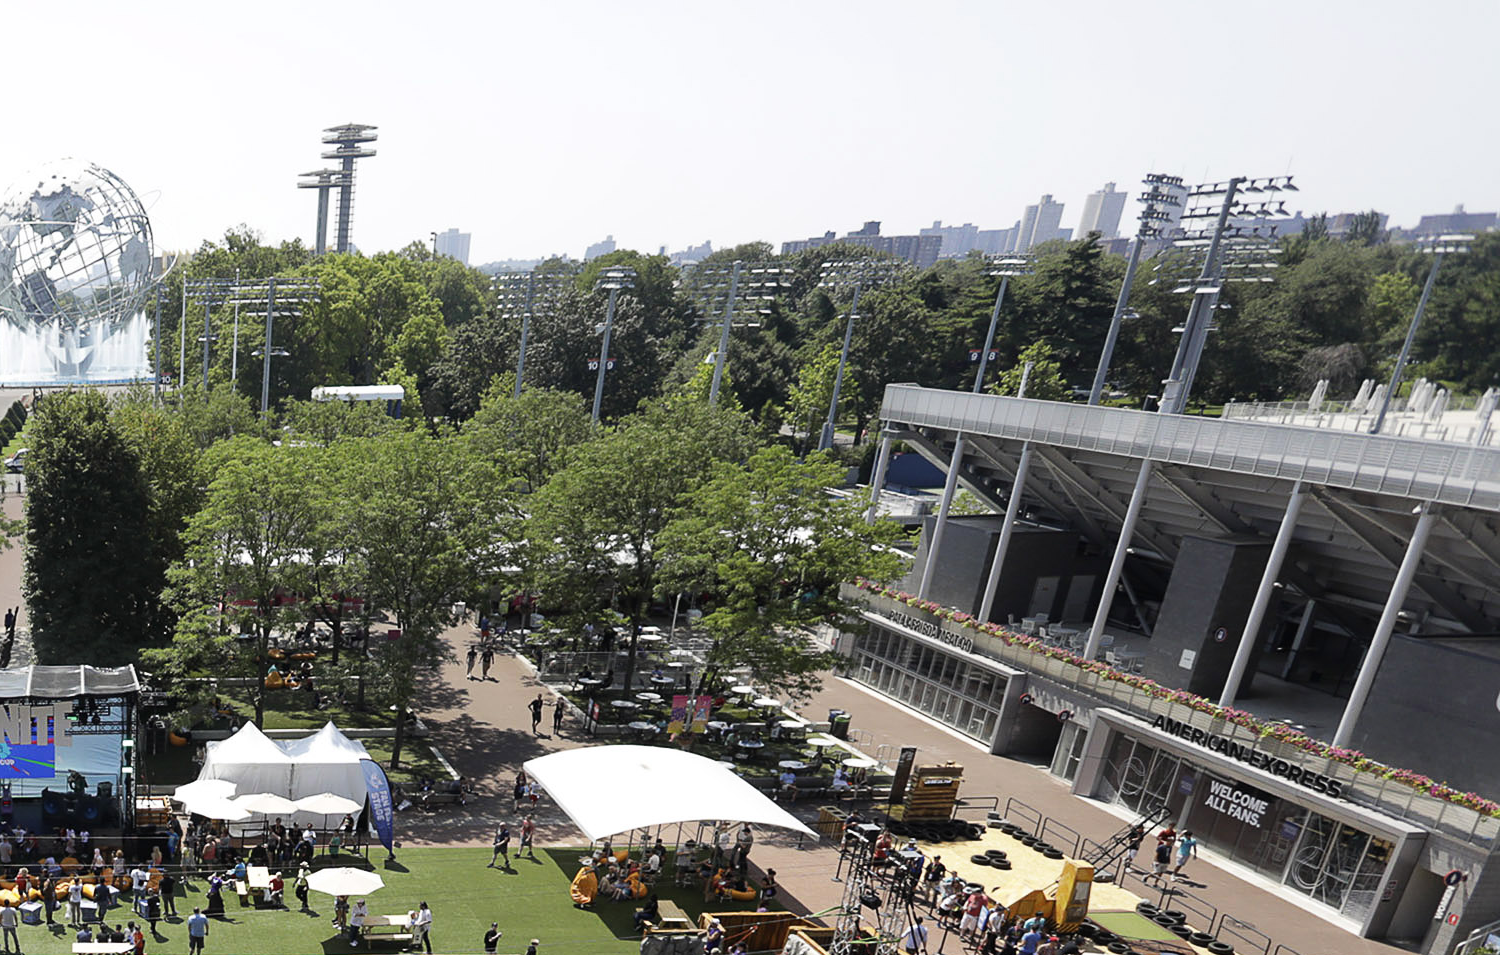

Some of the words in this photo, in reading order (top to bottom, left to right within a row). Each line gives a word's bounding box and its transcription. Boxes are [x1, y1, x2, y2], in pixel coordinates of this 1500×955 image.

[587, 361, 599, 370] 10
[606, 361, 614, 370] 9
[161, 375, 171, 384] 10
[0, 758, 15, 767] CUP
[1151, 714, 1247, 763] AMERICAN
[1249, 748, 1343, 799] EXPRESS
[371, 791, 385, 822] STAGE
[1210, 780, 1269, 815] WELCOME
[1204, 794, 1227, 813] ALL
[1227, 803, 1261, 828] FANS.
